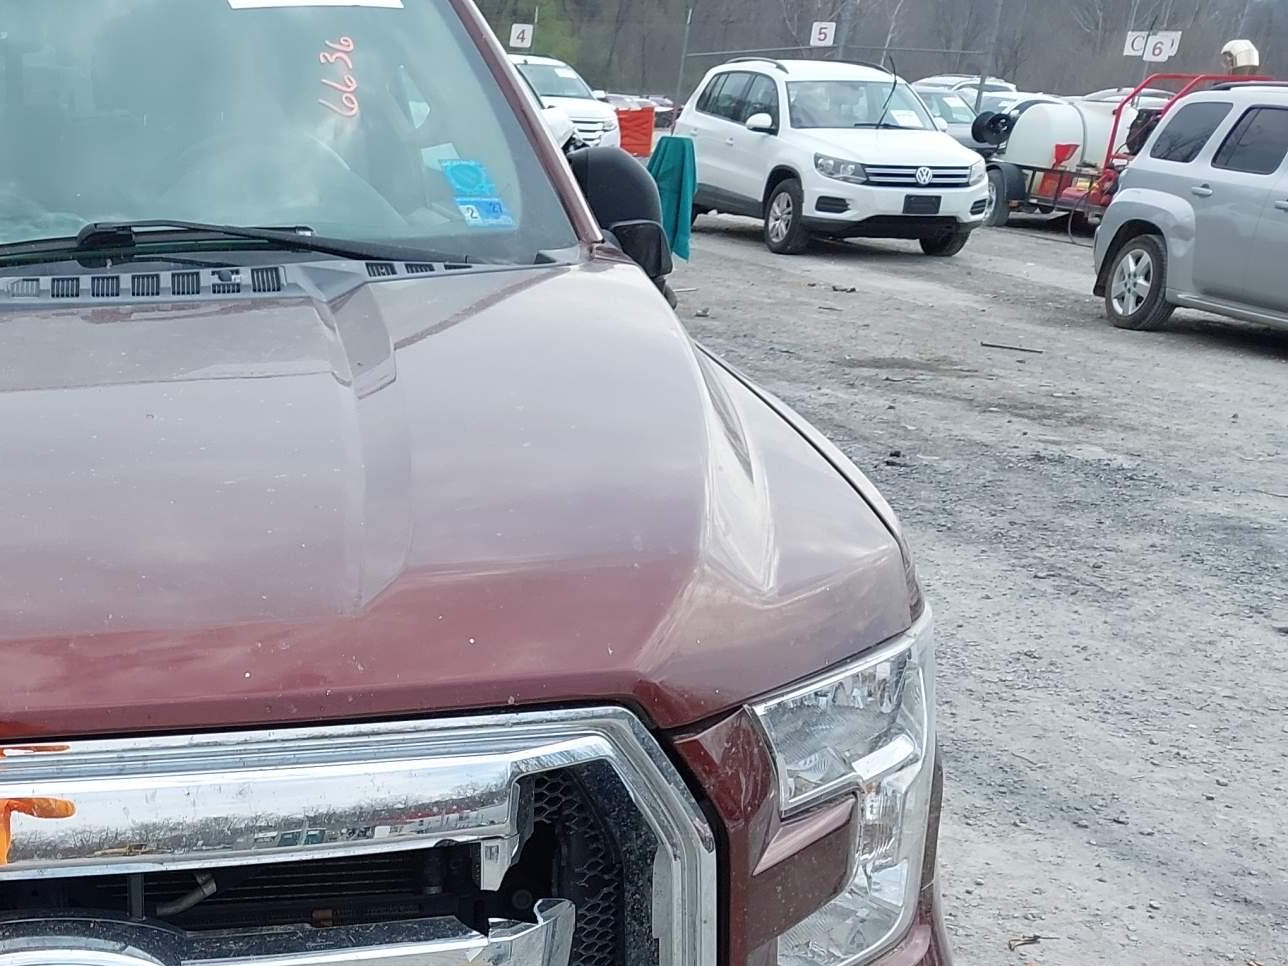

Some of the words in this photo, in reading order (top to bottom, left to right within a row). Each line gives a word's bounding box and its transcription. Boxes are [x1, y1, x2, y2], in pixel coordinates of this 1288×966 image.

[516, 29, 527, 43] 4
[817, 26, 829, 42] 5
[1152, 41, 1164, 57] 6
[317, 36, 359, 117] 6636
[466, 206, 479, 220] 2
